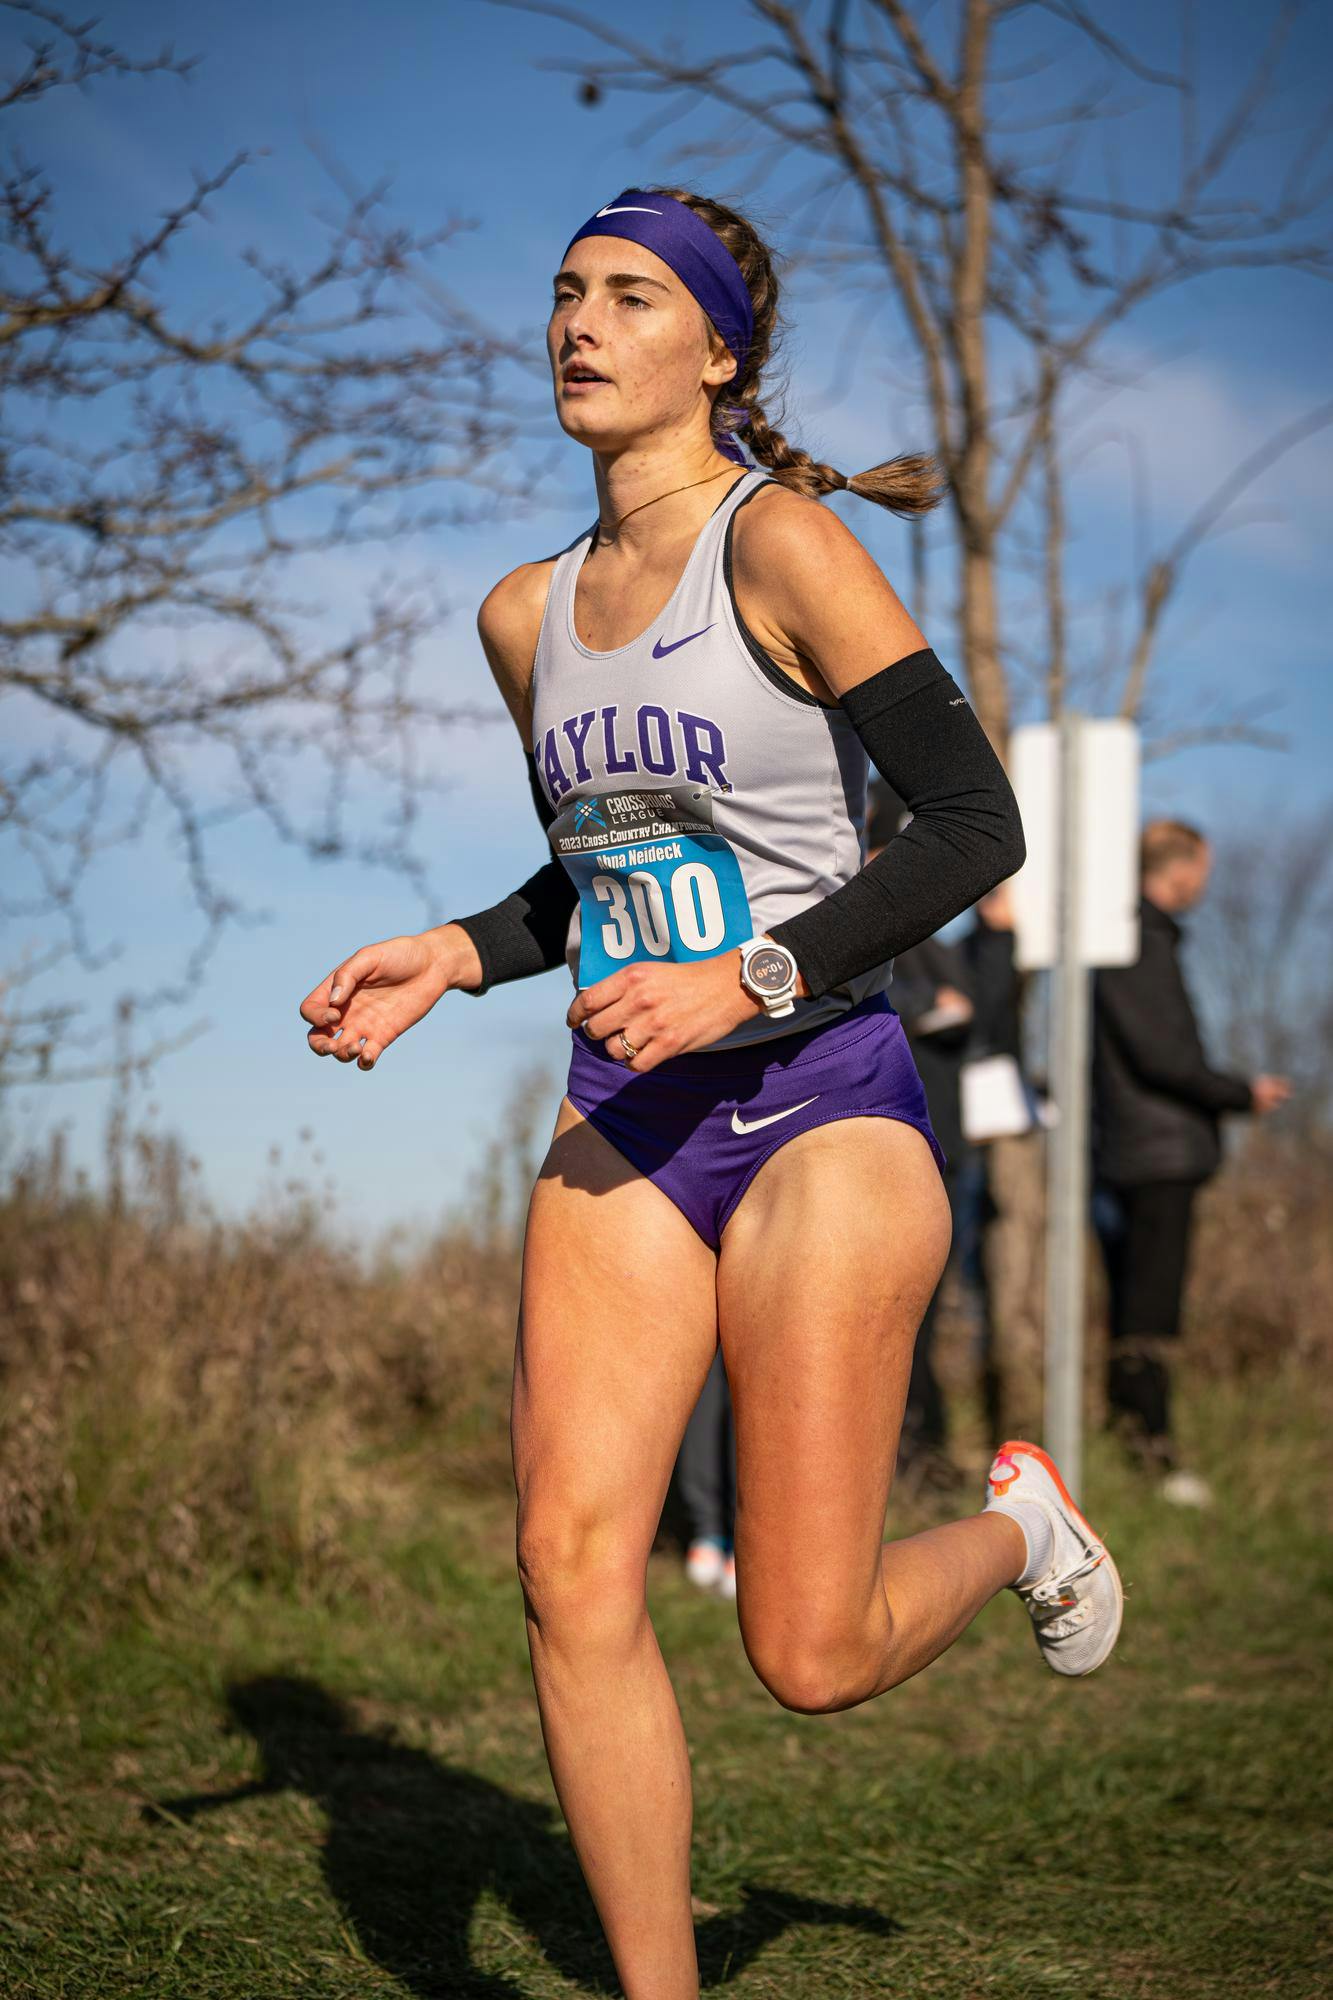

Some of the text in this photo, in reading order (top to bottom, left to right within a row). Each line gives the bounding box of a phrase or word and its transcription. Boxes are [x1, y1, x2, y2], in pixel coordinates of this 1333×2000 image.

[533, 703, 735, 807] AYLOR
[606, 794, 676, 815] CROSSROADS
[611, 808, 664, 824] LEAGUE
[559, 835, 581, 851] 2023
[628, 842, 683, 866] Neideck
[592, 862, 726, 960] 300
[756, 961, 783, 979] 10:49
